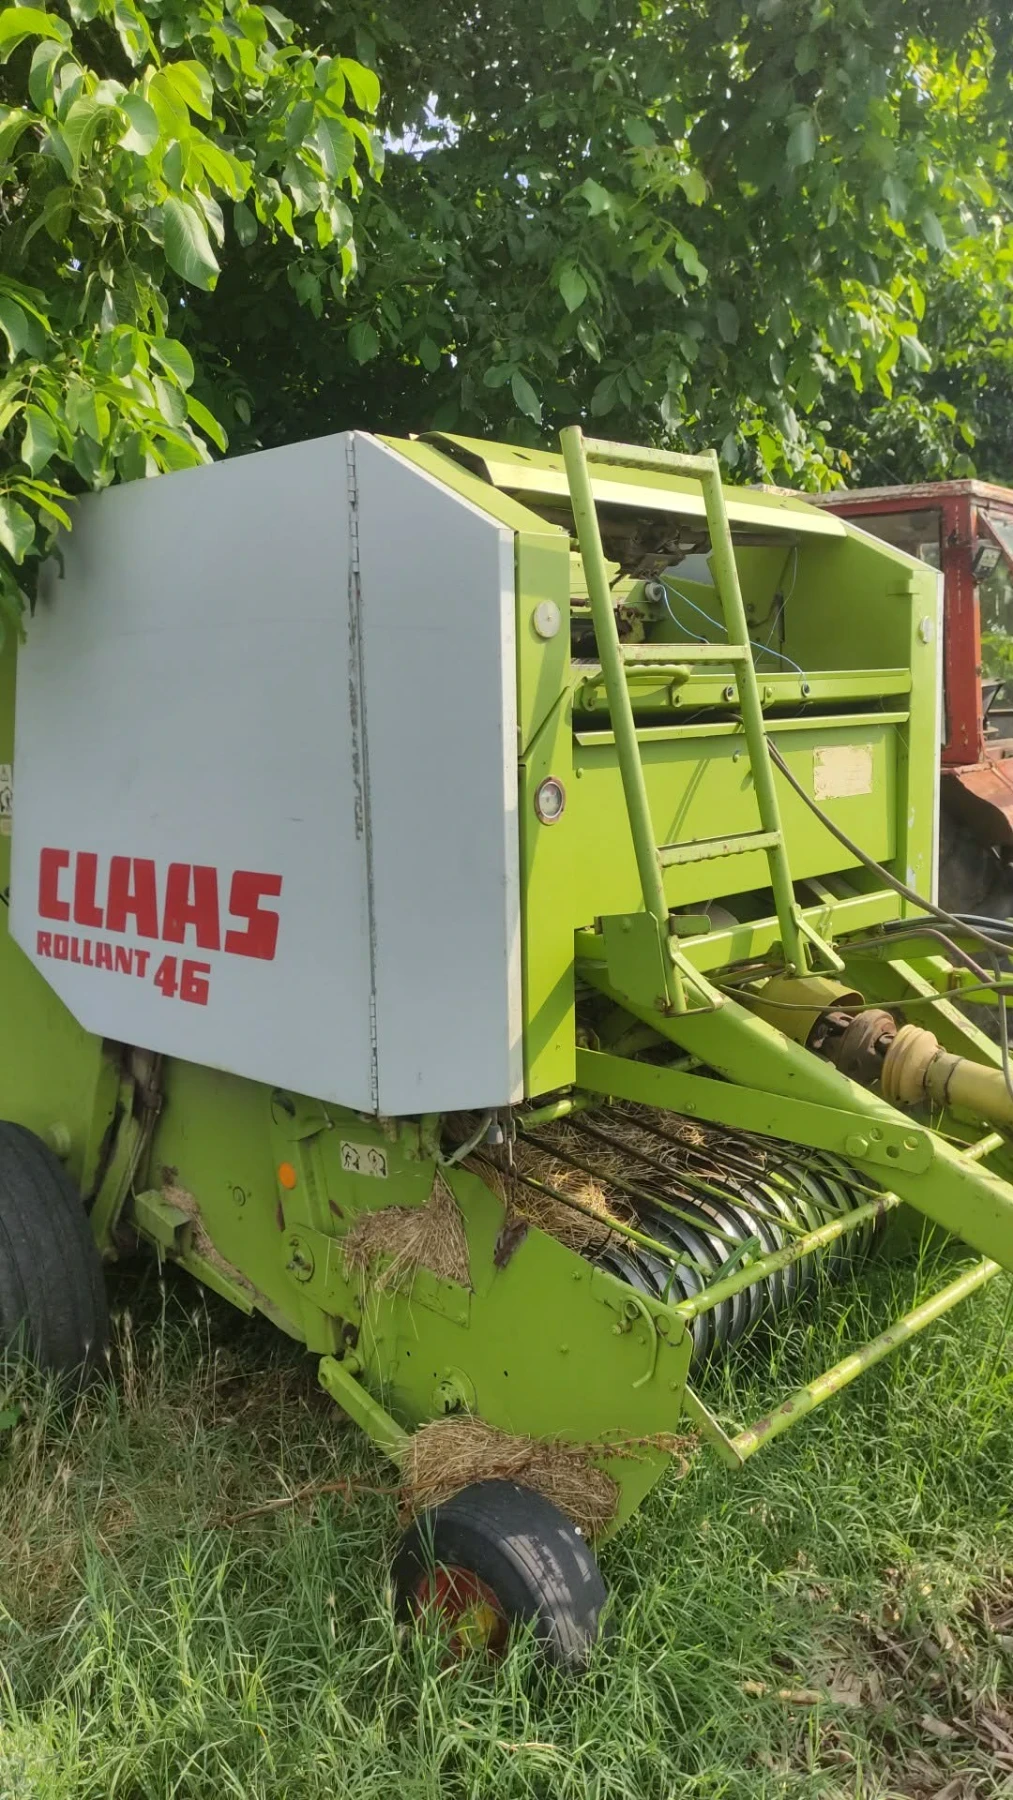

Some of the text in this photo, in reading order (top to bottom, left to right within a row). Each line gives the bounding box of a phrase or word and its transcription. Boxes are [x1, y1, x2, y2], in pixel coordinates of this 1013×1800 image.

[38, 847, 283, 961] CLAAS
[37, 930, 212, 1006] ROLLANT 46
